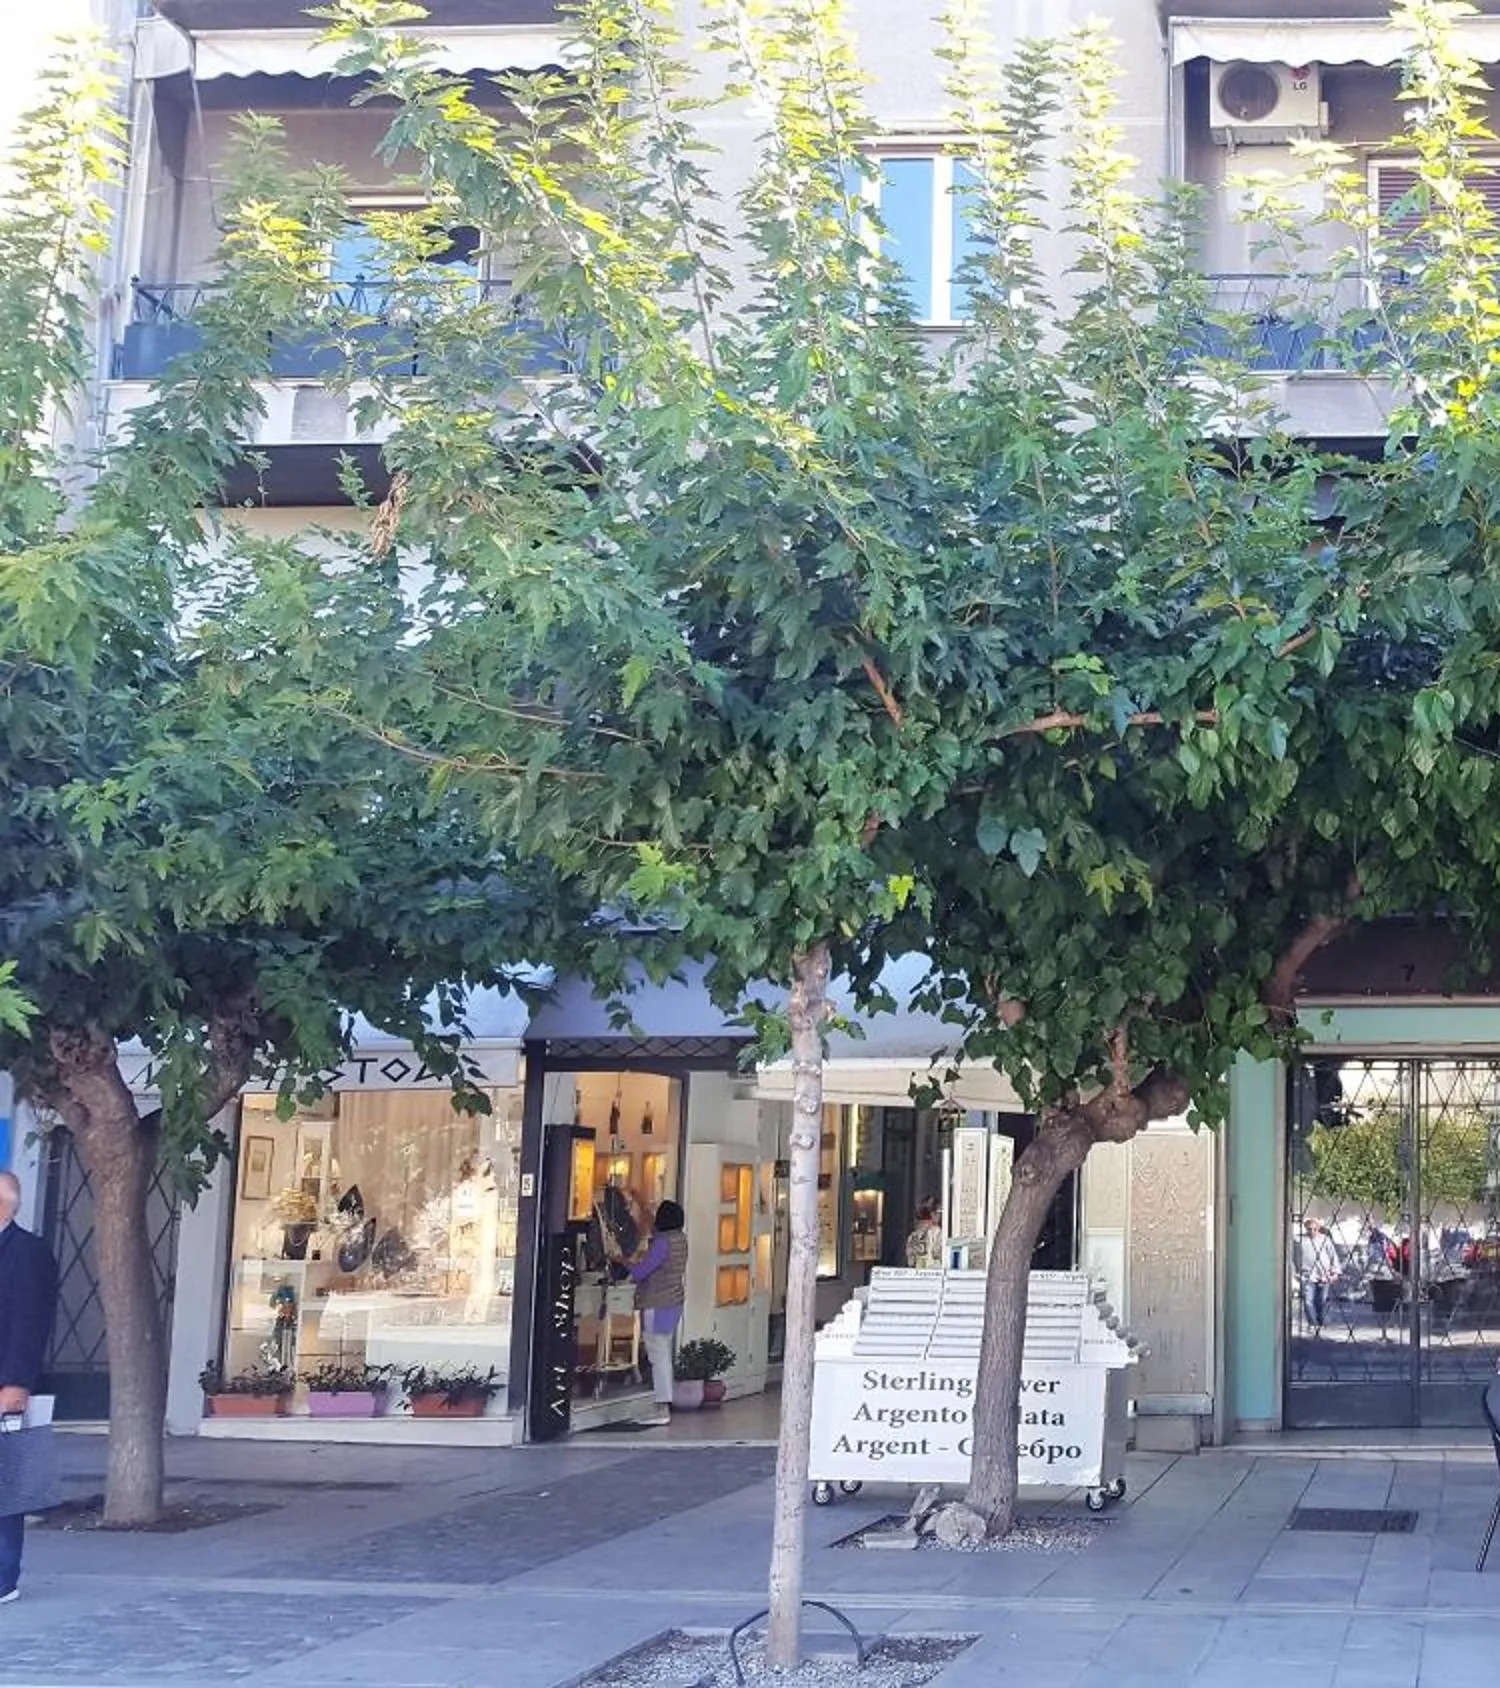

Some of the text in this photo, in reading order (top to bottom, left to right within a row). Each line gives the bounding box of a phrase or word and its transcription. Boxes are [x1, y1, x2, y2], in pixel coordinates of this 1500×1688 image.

[1293, 82, 1308, 91] LG
[863, 1369, 973, 1398] Sterling
[852, 1402, 968, 1429] Argento
[832, 1434, 931, 1461] Argent
